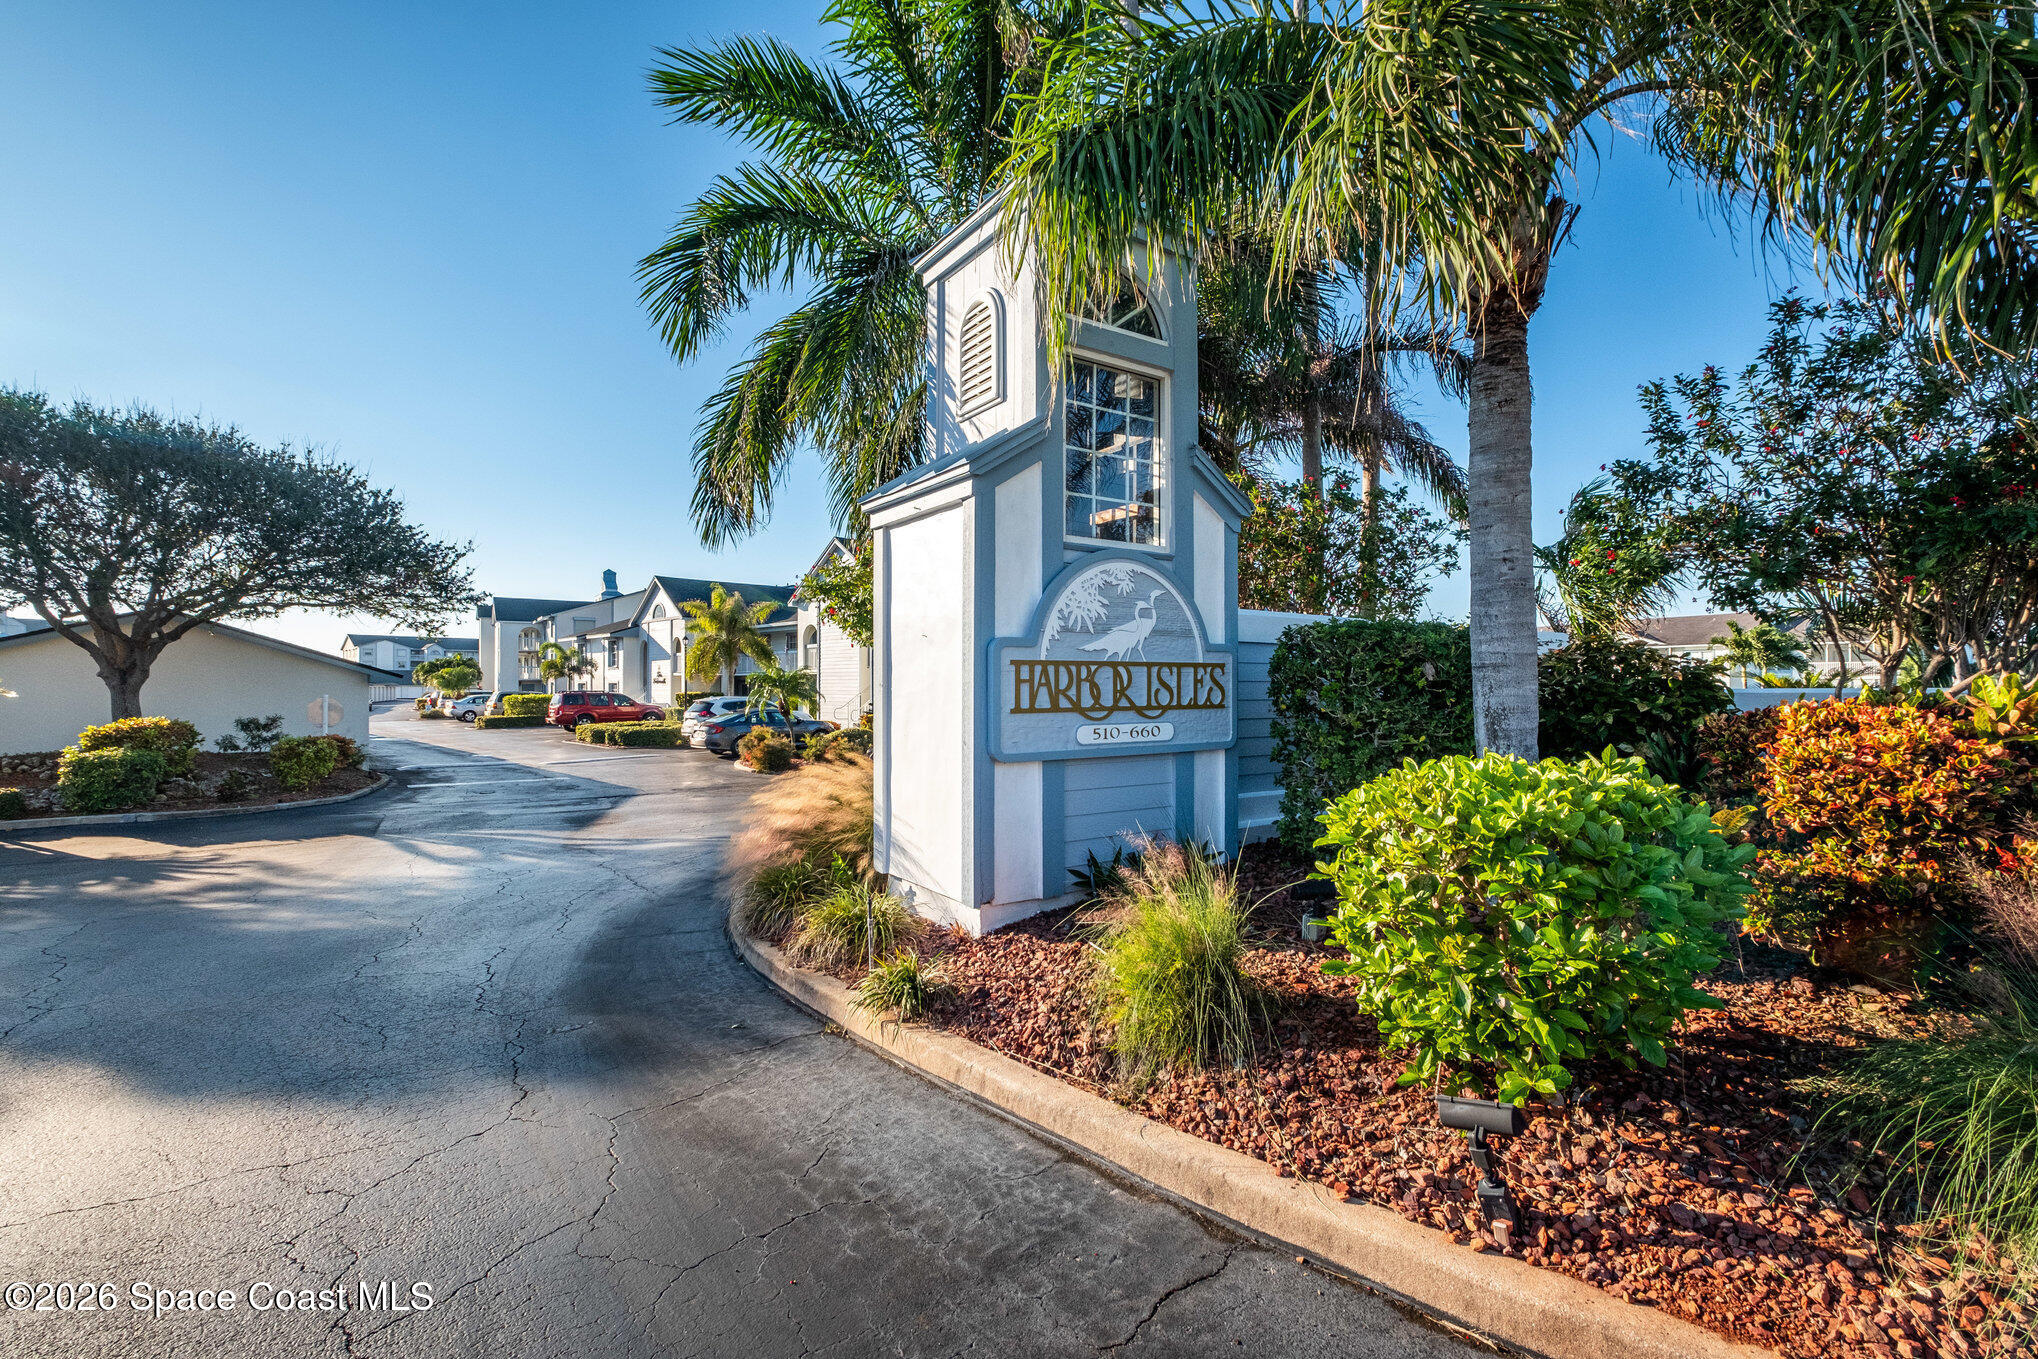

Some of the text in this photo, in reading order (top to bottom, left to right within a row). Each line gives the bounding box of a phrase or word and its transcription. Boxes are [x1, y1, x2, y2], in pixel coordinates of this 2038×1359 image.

[1010, 660, 1226, 721] HARBOR ISLES
[1092, 725, 1161, 741] 510-660
